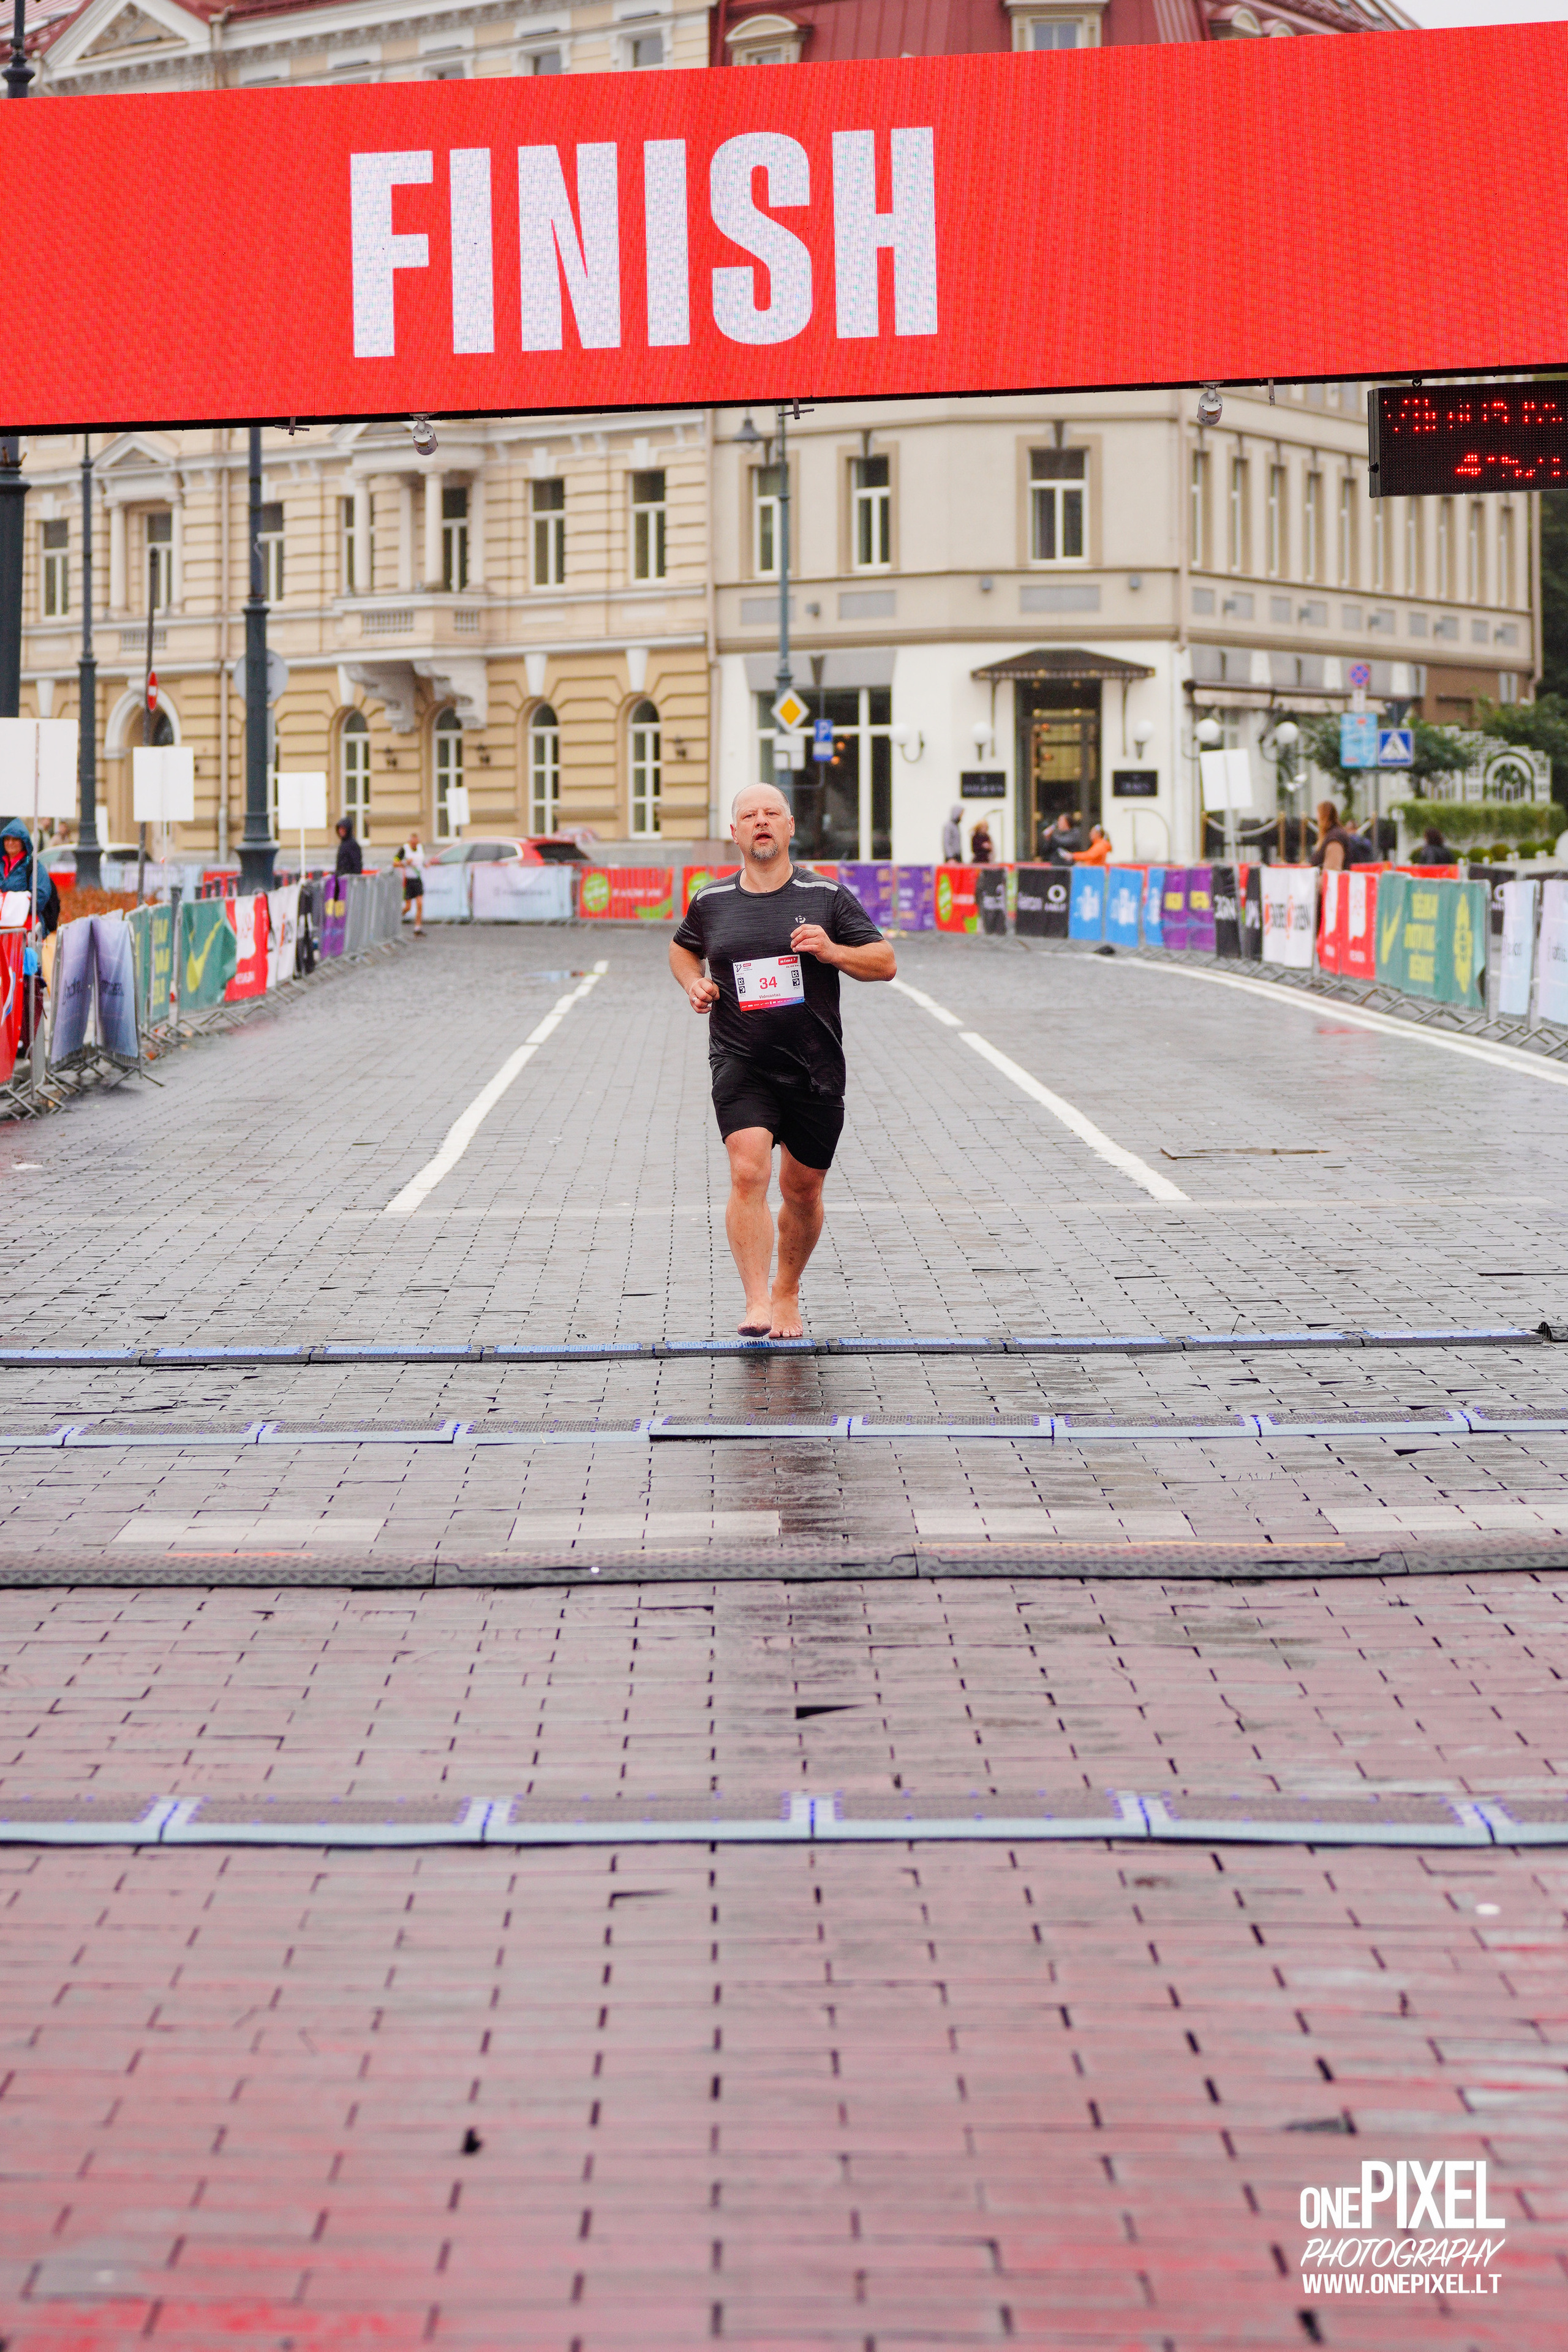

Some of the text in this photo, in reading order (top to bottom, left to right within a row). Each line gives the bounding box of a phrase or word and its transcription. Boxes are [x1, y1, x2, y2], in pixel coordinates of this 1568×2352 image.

[350, 126, 938, 358] FINISH
[820, 722, 829, 738] P
[759, 976, 778, 989] 34
